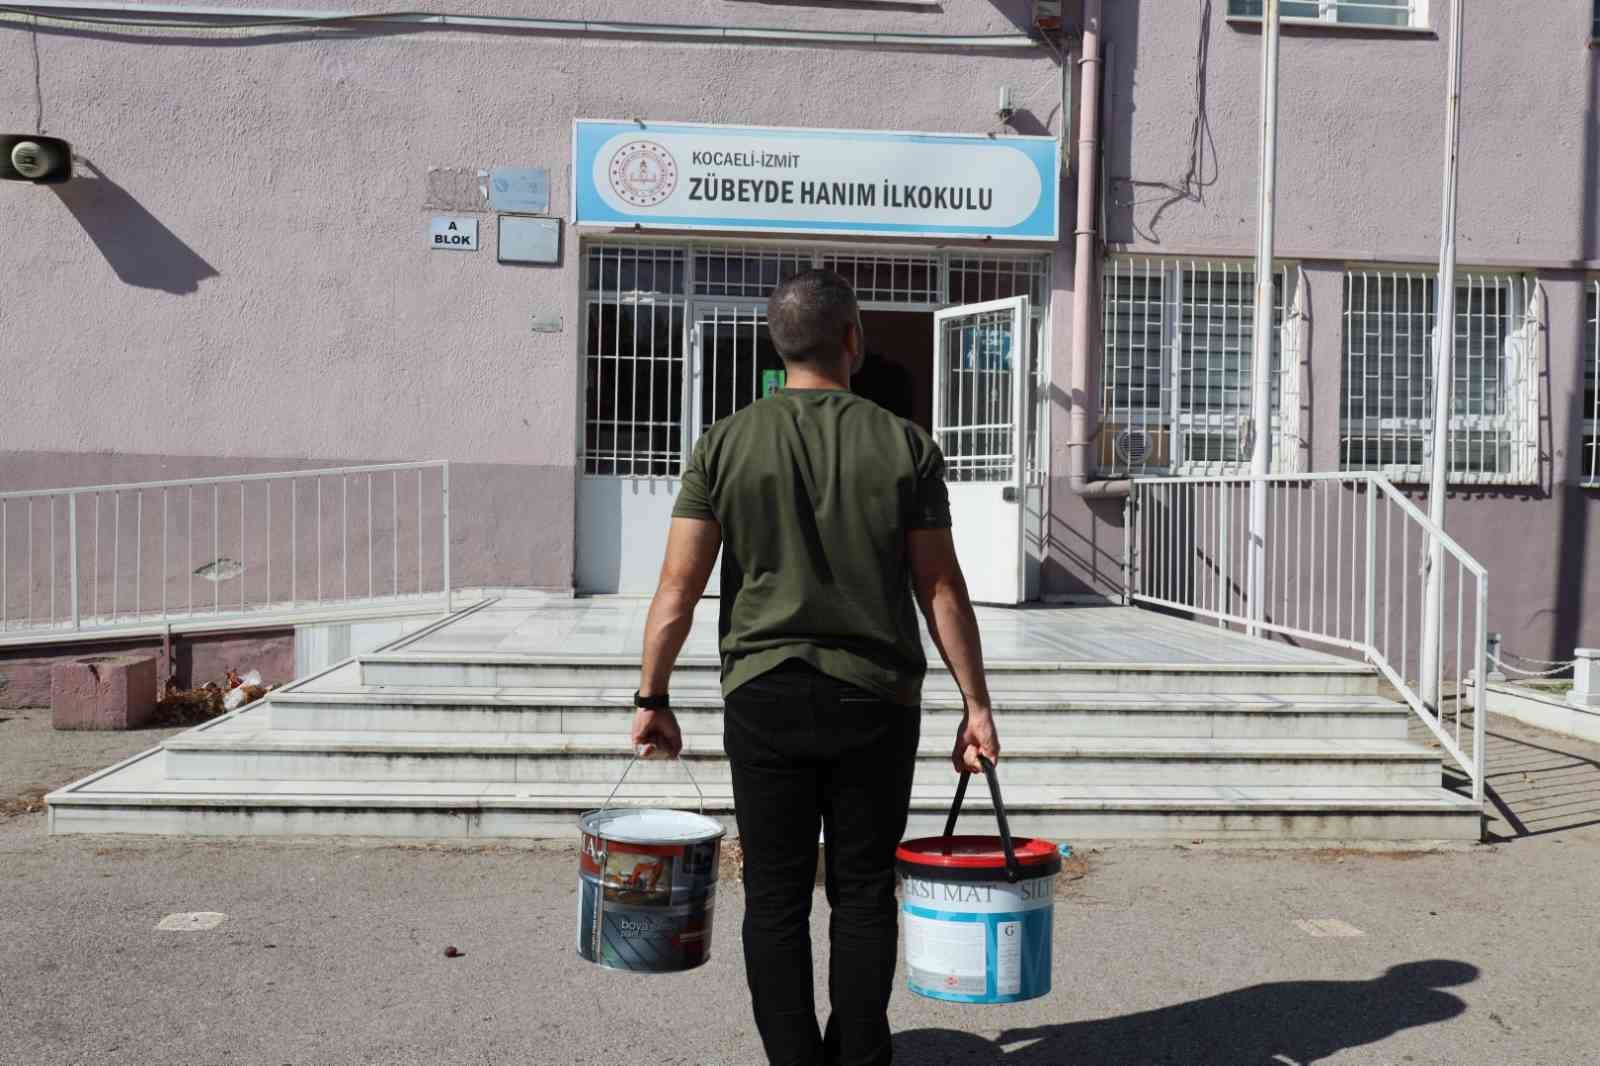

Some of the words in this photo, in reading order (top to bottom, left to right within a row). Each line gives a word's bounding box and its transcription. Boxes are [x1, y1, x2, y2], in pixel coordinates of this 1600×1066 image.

[692, 151, 800, 170] KOCAELİ-İZMİT
[688, 174, 795, 205] ZÜBEYDE
[800, 180, 876, 207] HANIM
[883, 179, 994, 211] İLKOKULU
[448, 221, 457, 231] A
[434, 234, 471, 245] BLOK
[944, 884, 993, 903] MAT
